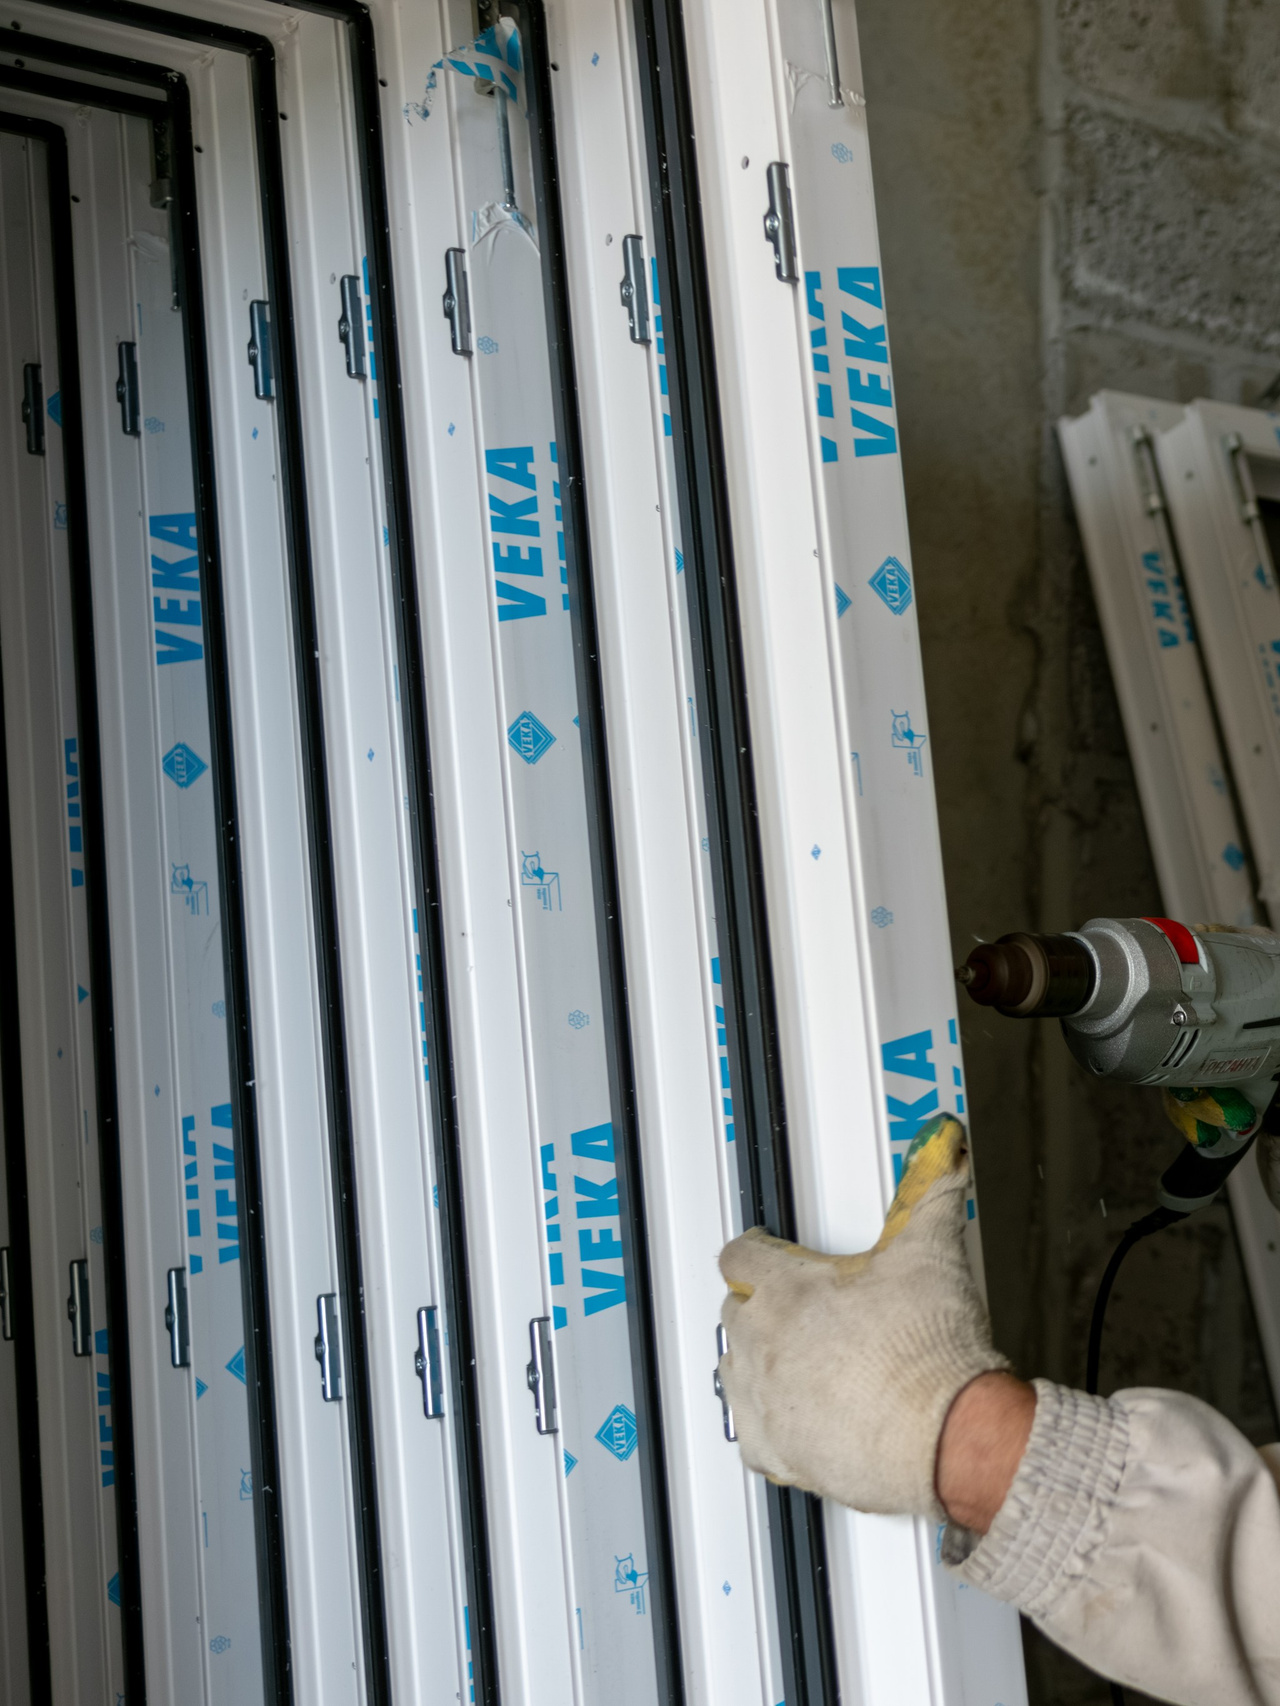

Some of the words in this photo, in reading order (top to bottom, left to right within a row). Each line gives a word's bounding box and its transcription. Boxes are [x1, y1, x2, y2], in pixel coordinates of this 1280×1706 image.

[837, 266, 897, 458] VEKA
[149, 512, 203, 666] VEKA
[485, 446, 547, 622] VEKA
[885, 567, 900, 604] VEKA
[1142, 551, 1180, 649] VEKA
[520, 720, 534, 754] VEKA
[881, 1029, 939, 1189] KA
[570, 1122, 627, 1317] VEKA
[612, 1414, 626, 1451] VEKA
